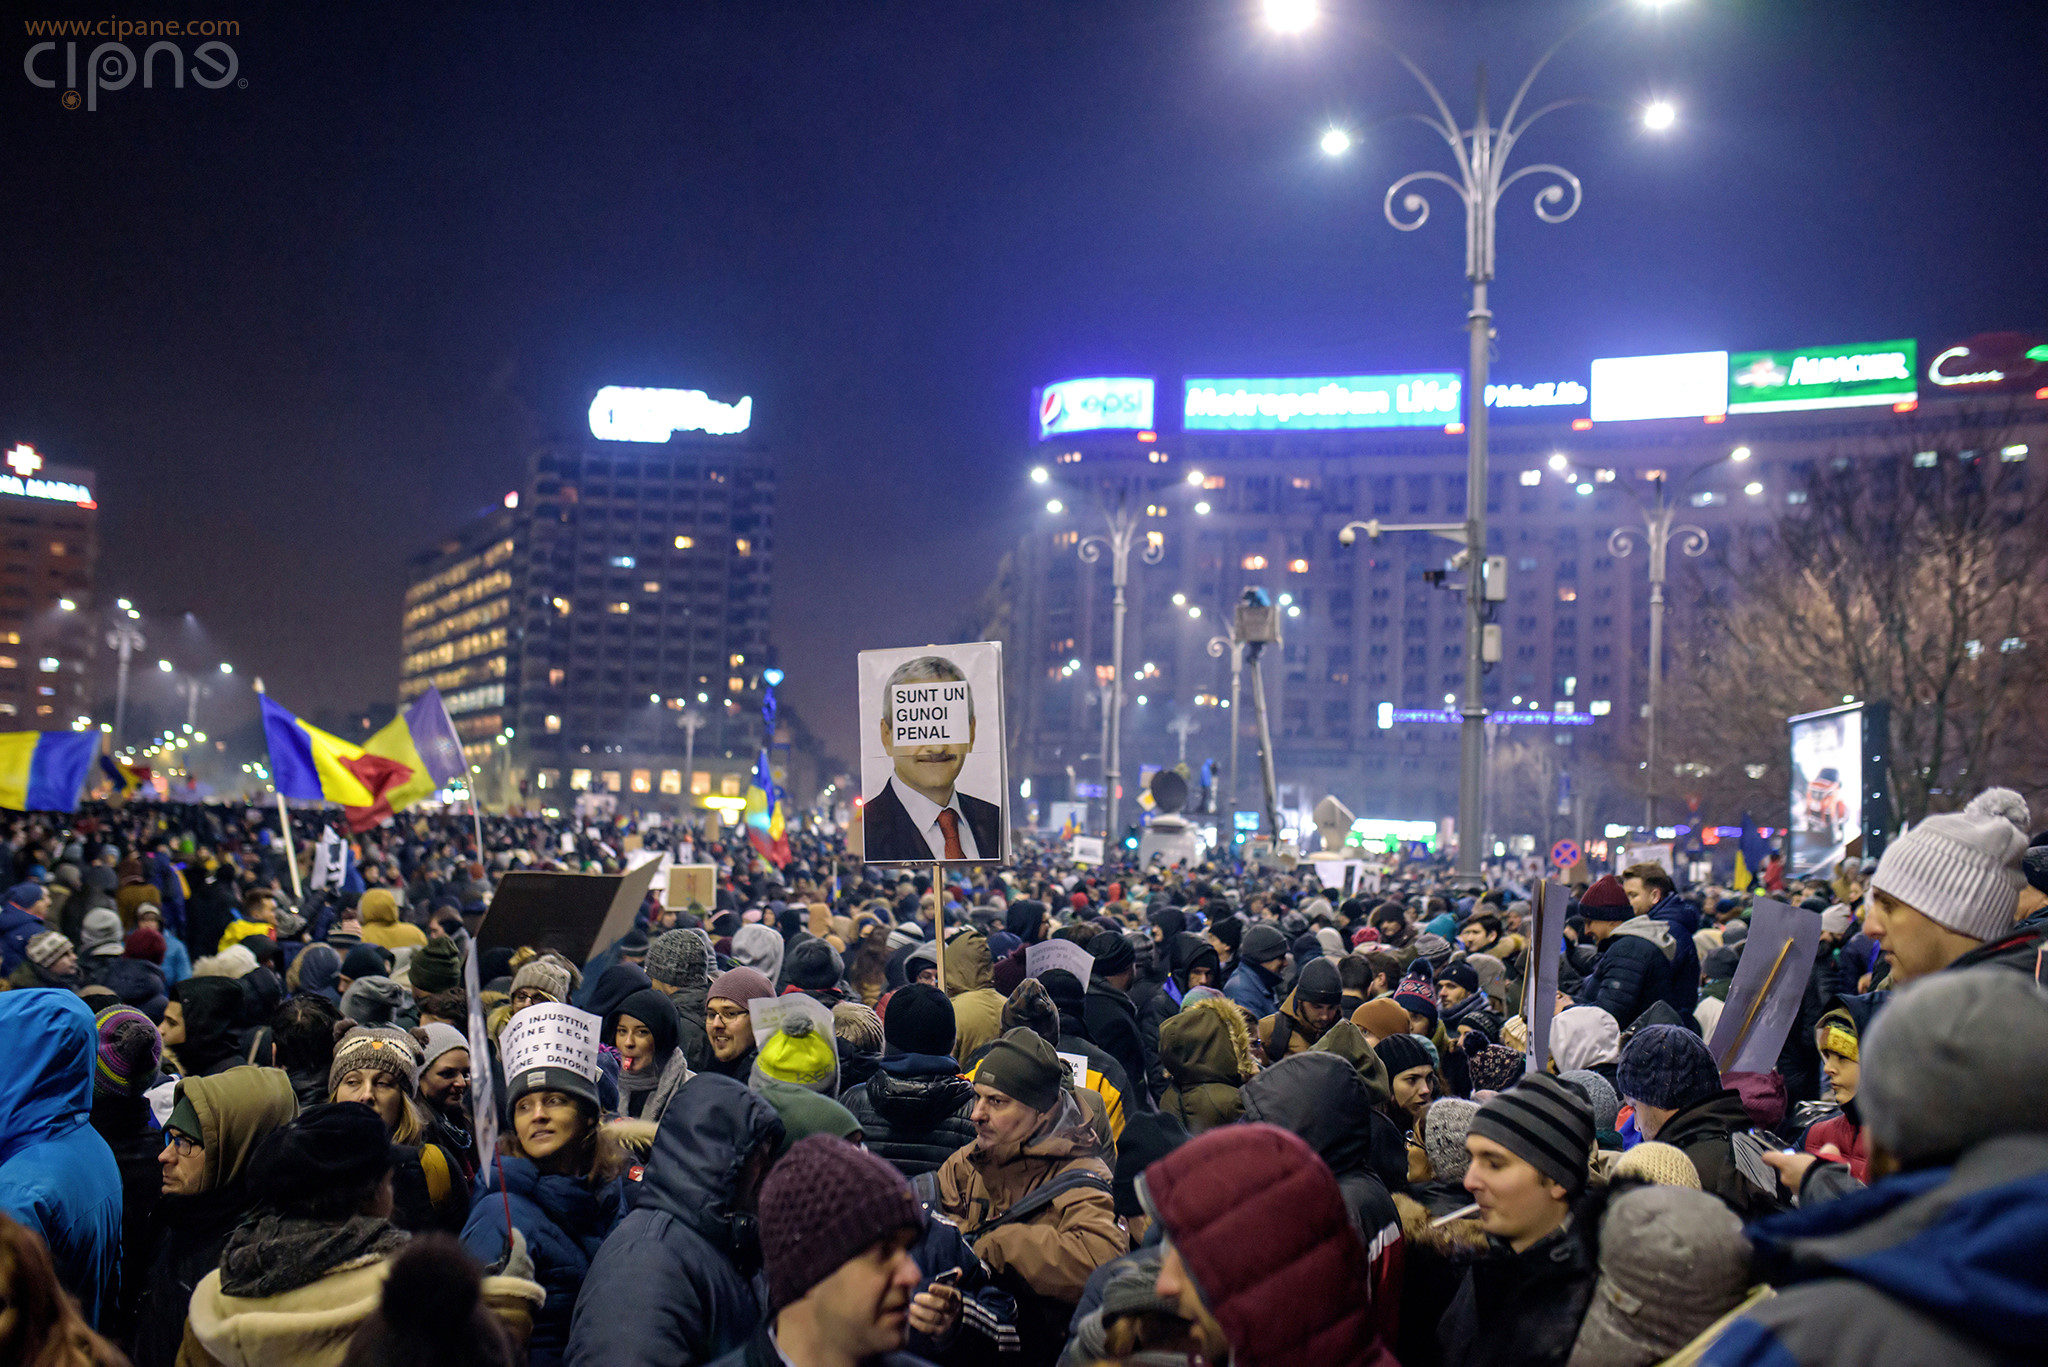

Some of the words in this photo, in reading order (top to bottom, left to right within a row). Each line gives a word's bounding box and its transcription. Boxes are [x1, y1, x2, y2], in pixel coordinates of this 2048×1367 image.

[1064, 389, 1142, 418] epsi
[896, 688, 939, 704] SUNT
[943, 687, 965, 702] UN
[896, 706, 948, 722] GUNOI
[896, 725, 950, 740] PENAL
[528, 1013, 590, 1032] INJUSTITIA
[557, 1026, 591, 1044] LEGE
[547, 1054, 589, 1076] DATORIE
